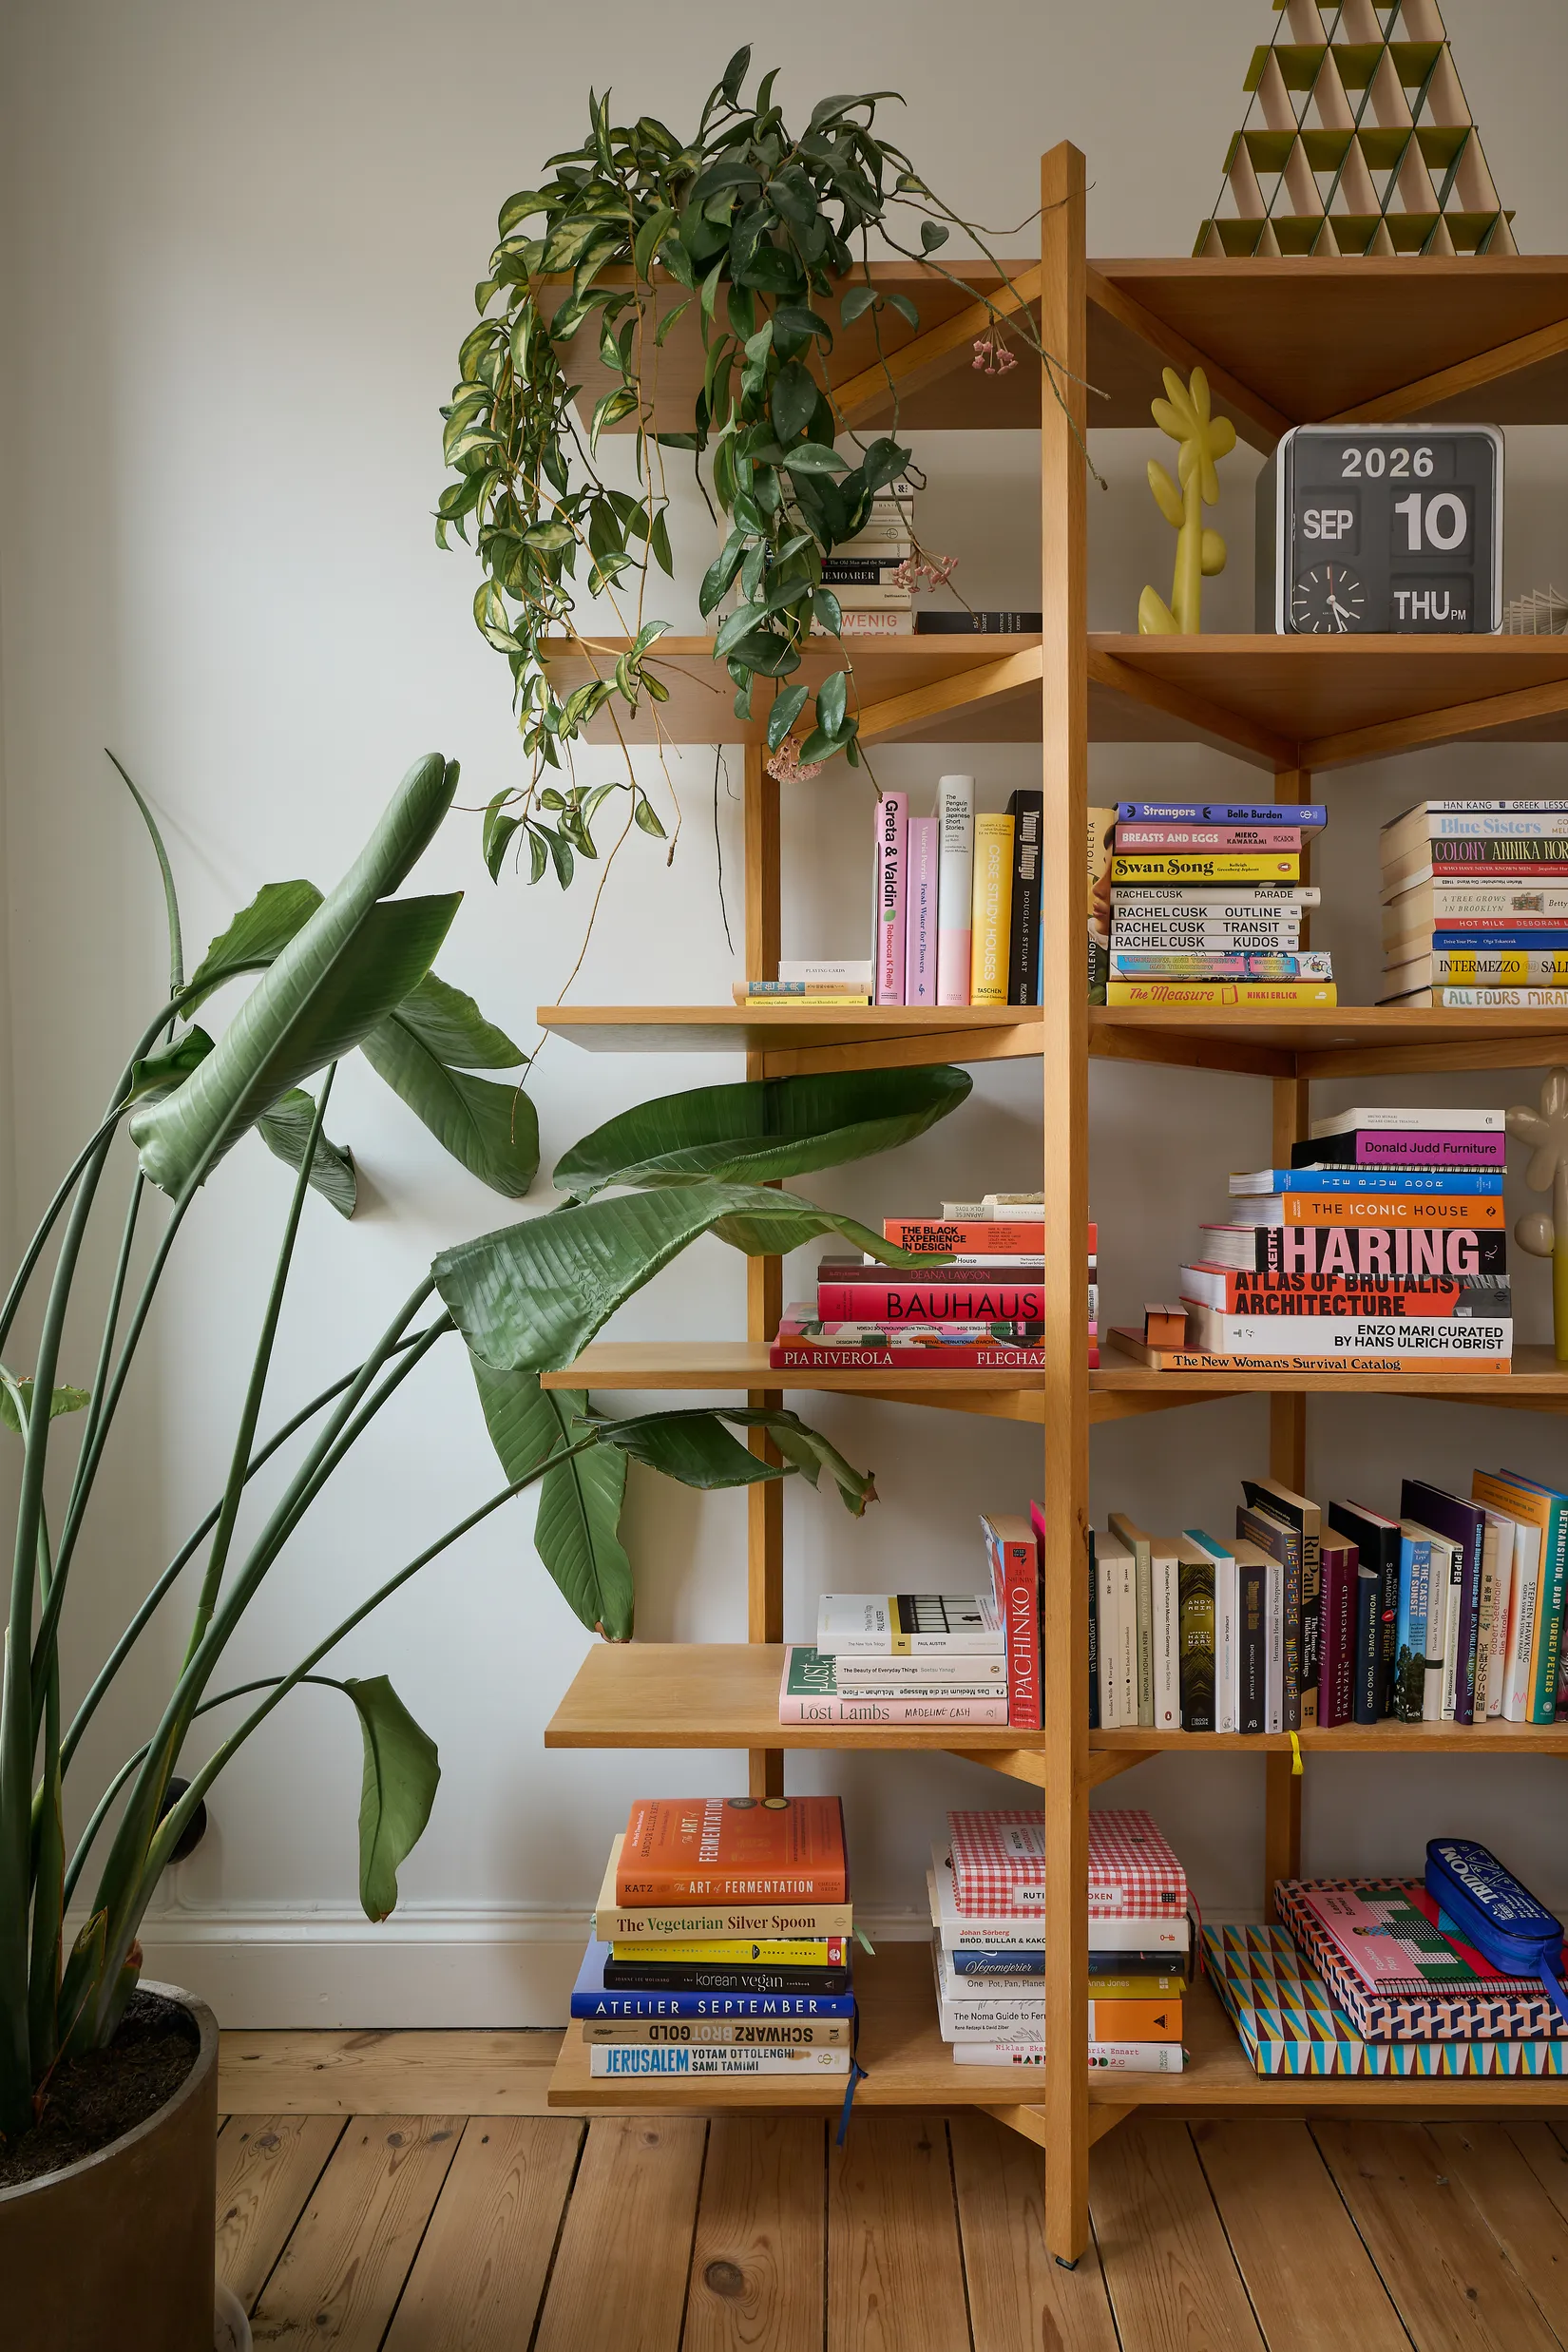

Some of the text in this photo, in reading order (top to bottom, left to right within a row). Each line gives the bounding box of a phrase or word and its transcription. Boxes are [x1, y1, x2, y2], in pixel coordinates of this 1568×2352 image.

[1341, 447, 1434, 478] 2026
[1303, 509, 1353, 540] SEP
[1395, 493, 1467, 551] 10
[1393, 591, 1450, 620] THU
[842, 614, 898, 629] WENIG
[1451, 609, 1466, 621] PM
[1143, 806, 1196, 820] Strangers
[1227, 810, 1283, 821] Belle Burden
[1441, 817, 1541, 833] Blue Sisters
[1122, 832, 1219, 844] BREASTS AND EGGS
[885, 800, 898, 907] Greta & Valdin
[1115, 859, 1214, 877] Swan Song
[1116, 890, 1182, 899] RACHEL CUSK
[1253, 890, 1292, 899] PARADE
[984, 845, 1000, 980] CASE STUDY HOUSES
[1118, 908, 1207, 918] RACHEL CUSK
[1224, 908, 1281, 918] OUTLINE
[1116, 922, 1205, 933] RACHEL CUSK
[1222, 922, 1279, 932] TRANSIT
[1115, 936, 1205, 947] RACHEL CUSK
[1233, 936, 1278, 947] KUDOS
[1440, 960, 1520, 973] INTERMEZZO
[1130, 985, 1214, 1001] The Measure
[1365, 1141, 1497, 1154] Donald Judd Furniture
[1312, 1203, 1468, 1216] THE ICONIC HOUSE
[1267, 1227, 1278, 1272] KEITH
[1283, 1226, 1480, 1275] HARING
[909, 1270, 991, 1280] DEANA LAWSON
[1235, 1273, 1467, 1294] ATLAS OF BRUTALIST
[887, 1292, 1040, 1319] BAUHAUS
[1235, 1294, 1406, 1316] ARCHITECTURE
[1357, 1325, 1503, 1338] ENZO MARI CURATED
[1334, 1336, 1504, 1349] BY HANS ULRICH OBRIST
[784, 1351, 895, 1365] PIA RIVEROLA
[1172, 1355, 1402, 1371] The New Woman's Survival Catalog
[1553, 1509, 1568, 1610] DETRANSITION, BABY
[1303, 1536, 1320, 1601] RuPaul
[1411, 1564, 1420, 1578] ON
[1453, 1554, 1463, 1583] PIPER
[1410, 1579, 1420, 1616] SUNSET
[1489, 1578, 1502, 1655] Robert Seethaler
[1522, 1581, 1536, 1663] STEPHEN HAWKING
[1011, 1586, 1033, 1700] PACHINKO
[1545, 1616, 1559, 1693] TORREY PETERS
[800, 1702, 890, 1720] Lost Lambs
[698, 1798, 723, 1863] FERMENTATION
[1438, 1846, 1500, 1904] TRIDOM
[624, 1884, 654, 1893] KATZ
[1324, 1897, 1343, 1915] Lesley
[1336, 1897, 1356, 1916] Barnes
[618, 1915, 816, 1934] The Vegetarian Silver Spoon
[983, 1928, 1010, 1937] Sörberg
[1364, 1946, 1387, 1972] Fashion
[1384, 1956, 1402, 1972] Play
[966, 1960, 1033, 1975] Vegomejerier
[967, 1979, 1045, 1988] One Pot, Pan, Planet
[596, 1999, 818, 2015] ATELIER SEPTEMBER
[605, 2049, 689, 2073] JERUSALEM
[692, 2048, 794, 2059] YOTAM OTTOLENGHI
[692, 2060, 759, 2072] SAMI TAMIMI
